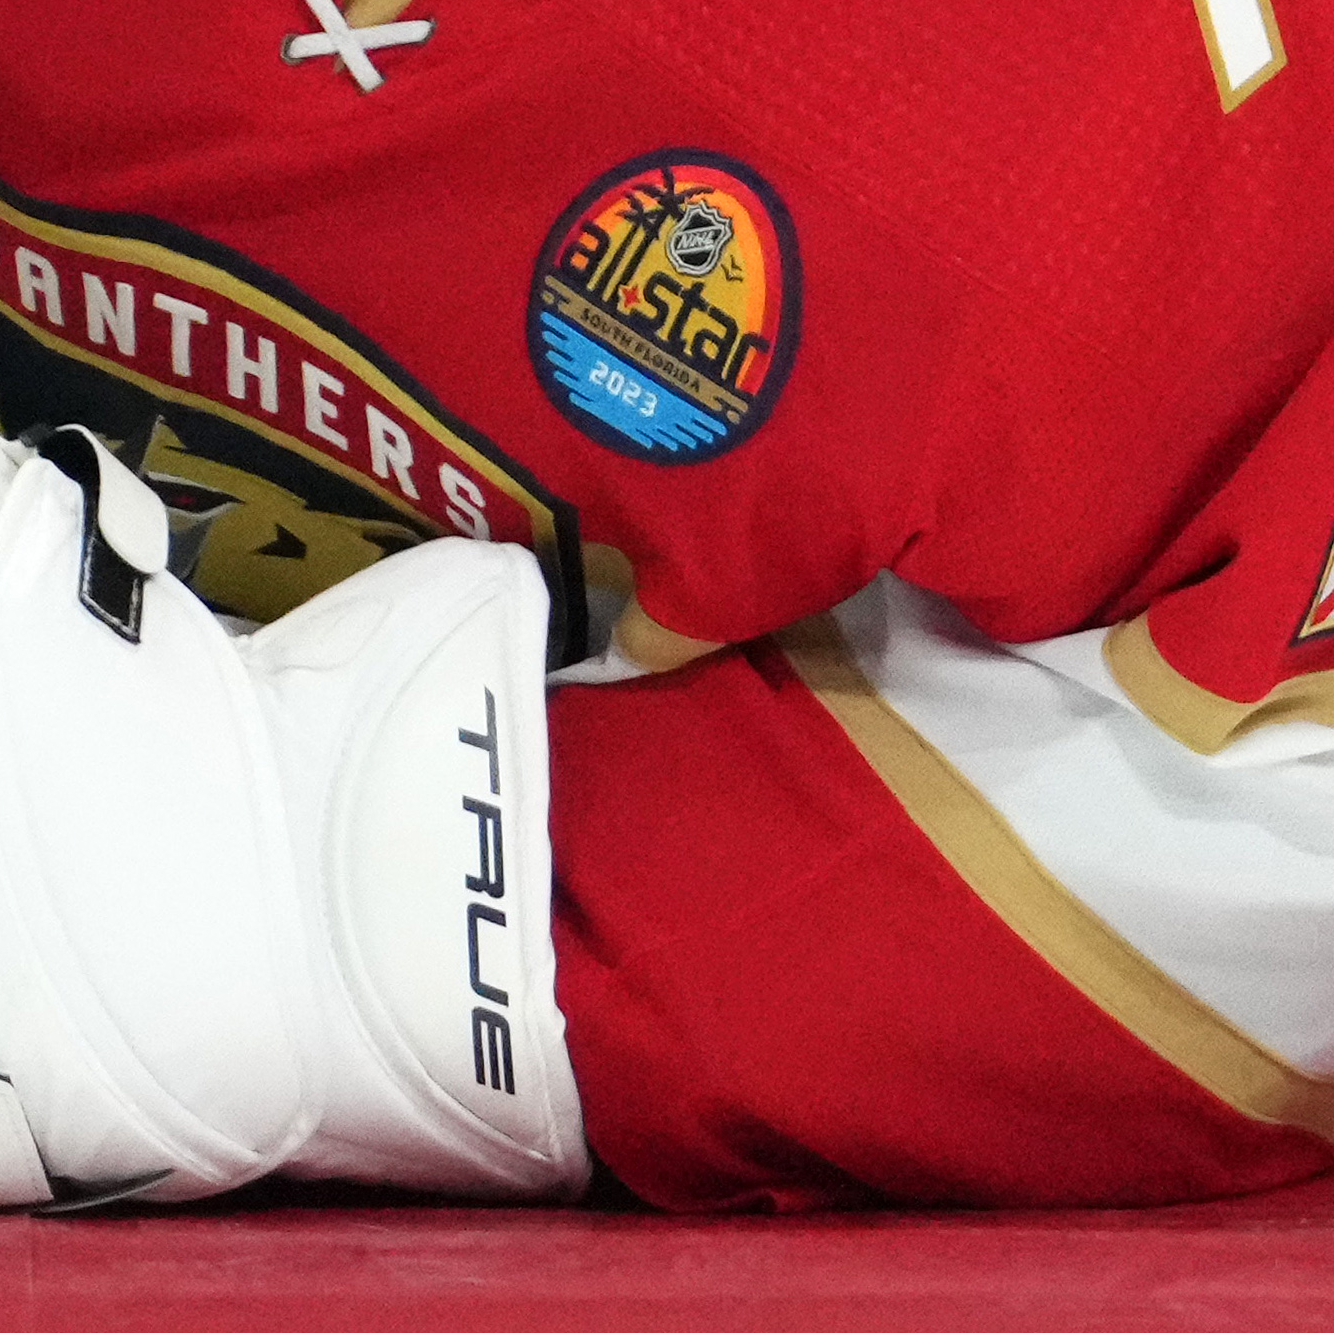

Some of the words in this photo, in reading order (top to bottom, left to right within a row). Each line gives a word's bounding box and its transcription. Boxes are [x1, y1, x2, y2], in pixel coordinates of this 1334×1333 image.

[677, 231, 715, 249] NHL
[589, 360, 658, 417] 2023
[458, 685, 515, 1095] TRUE
